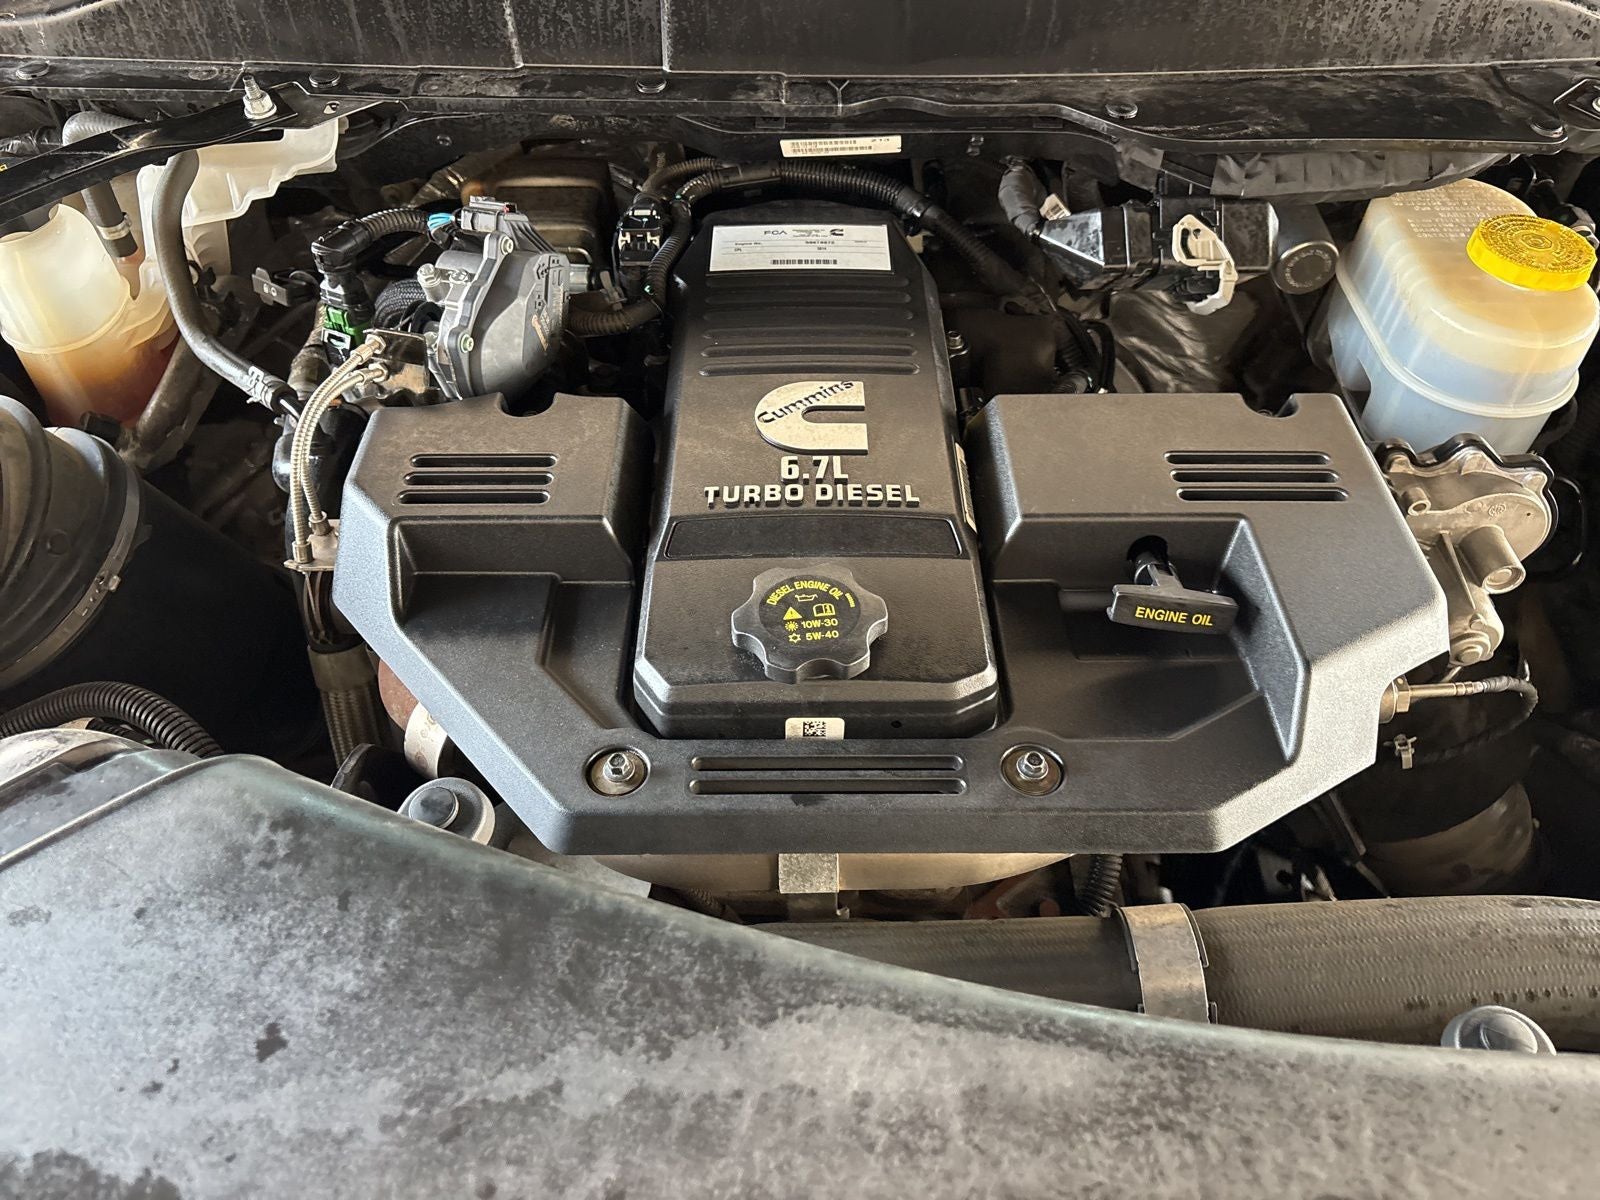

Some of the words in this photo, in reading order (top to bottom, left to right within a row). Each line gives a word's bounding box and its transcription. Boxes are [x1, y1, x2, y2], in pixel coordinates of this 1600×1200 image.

[757, 380, 854, 424] Cummins
[780, 455, 849, 482] 6.7L
[704, 484, 804, 506] TURBO
[815, 483, 920, 505] DIESEL
[766, 585, 794, 605] DIESEL
[793, 580, 831, 592] ENGINE
[828, 587, 844, 600] OIL
[801, 618, 839, 629] 10W-30
[1135, 605, 1188, 624] ENGINE
[1191, 613, 1213, 626] OIL
[805, 630, 839, 641] 5W-40
